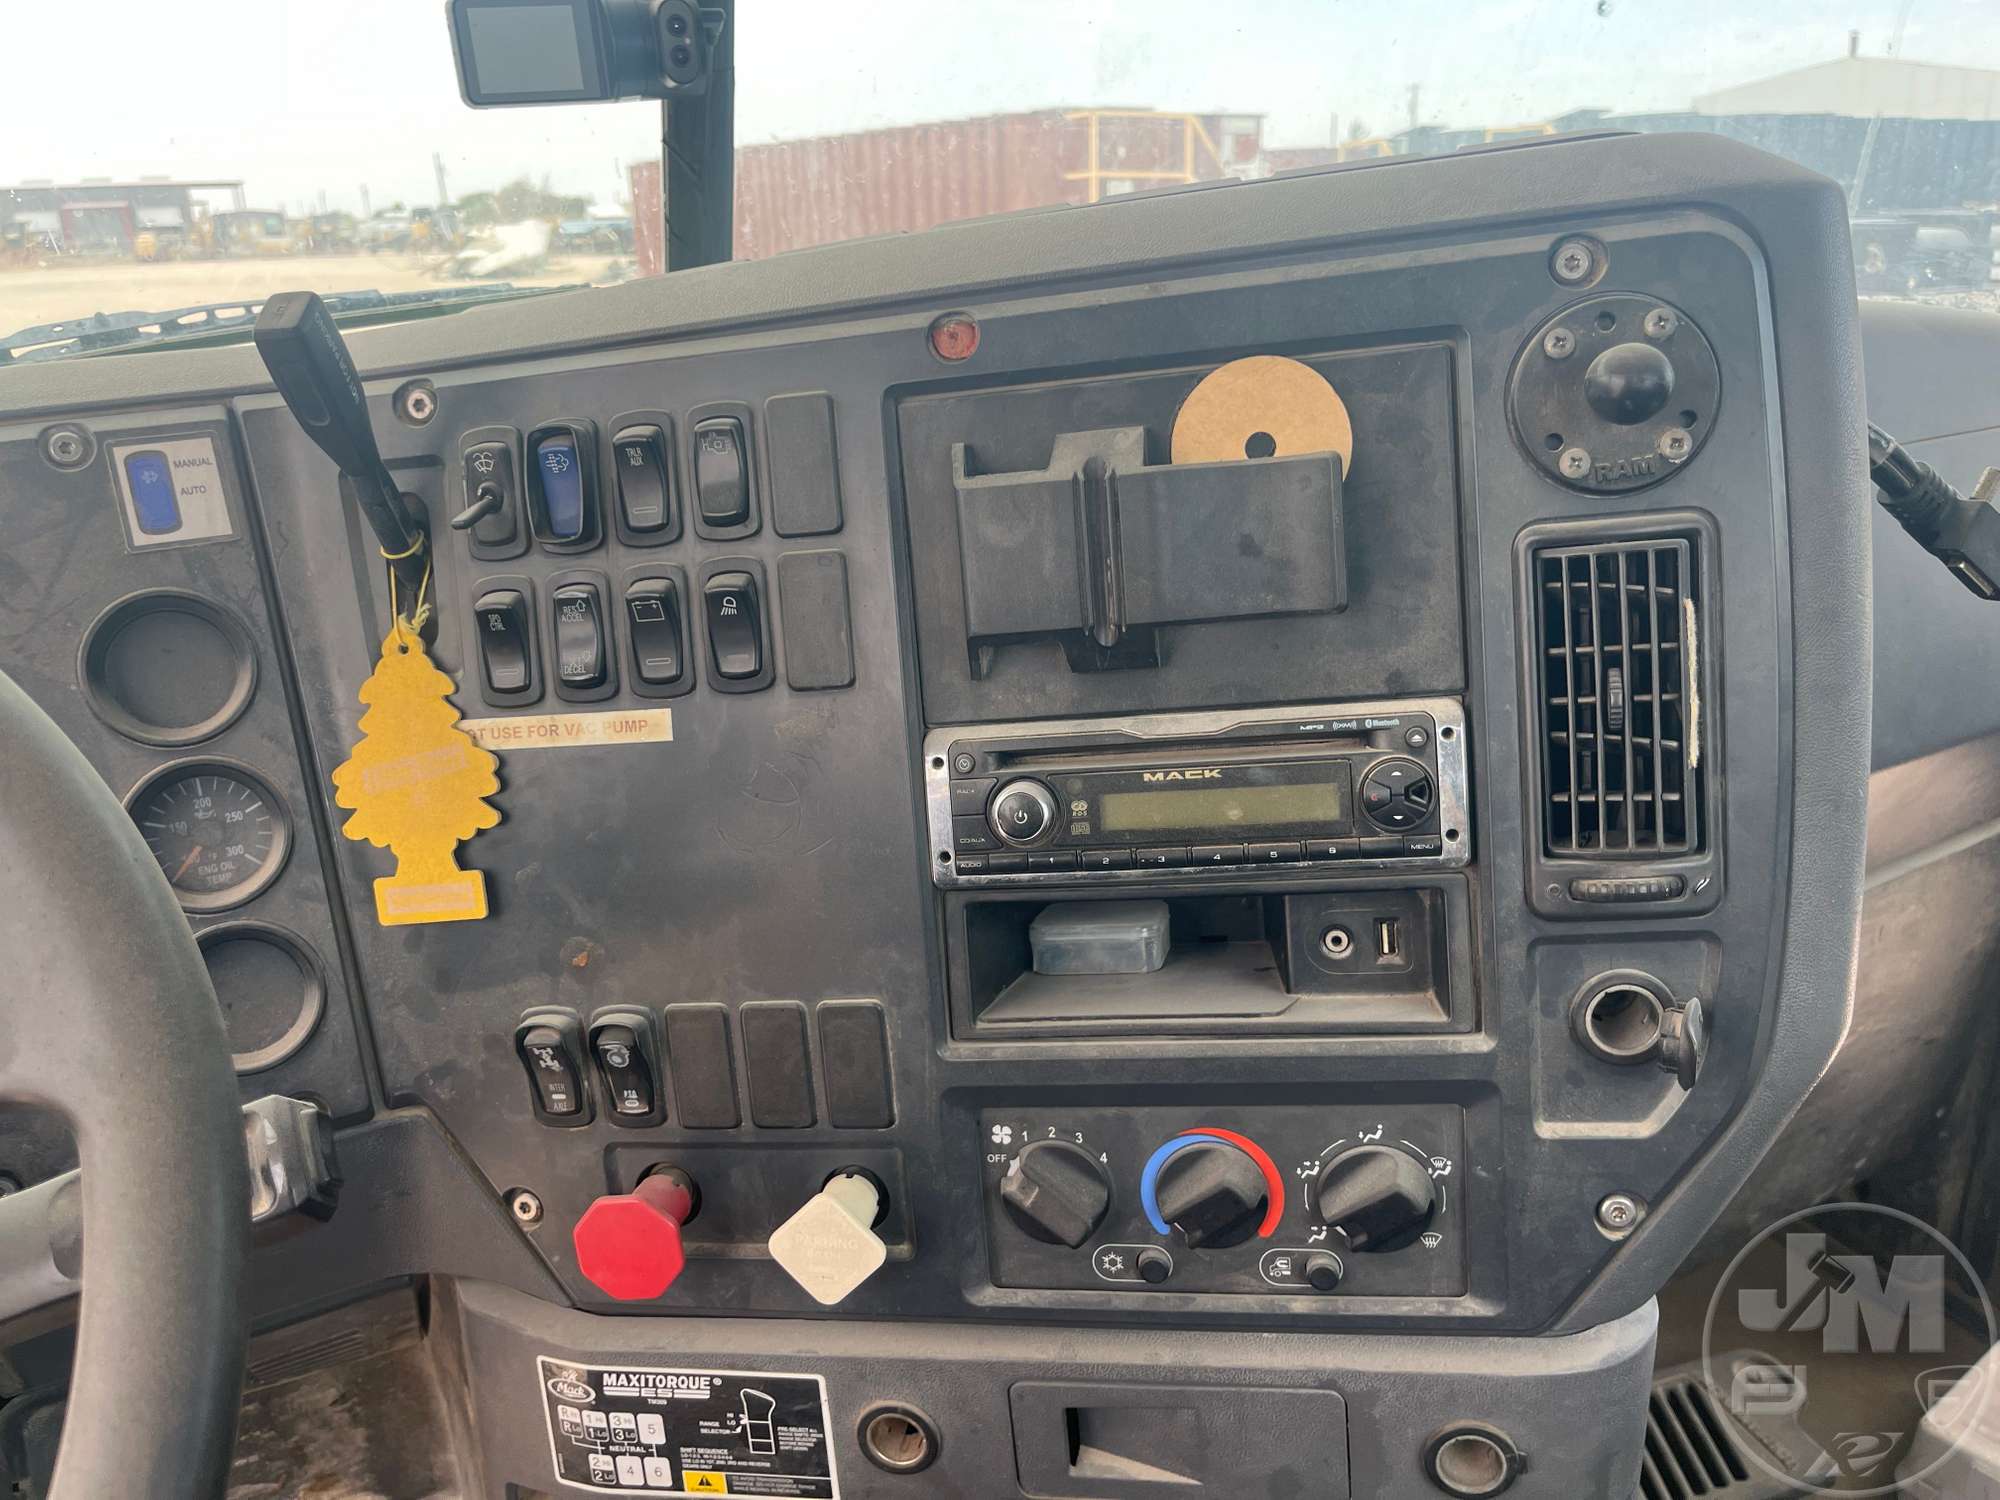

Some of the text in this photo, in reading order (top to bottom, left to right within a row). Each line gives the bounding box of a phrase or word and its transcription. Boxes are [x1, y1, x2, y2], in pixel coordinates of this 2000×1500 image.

[625, 447, 643, 457] TRLR
[173, 457, 214, 469] MANUAL
[630, 457, 644, 467] AUX
[1594, 457, 1657, 483] RAM
[180, 485, 207, 497] AUTO
[561, 613, 585, 623] ACCEL
[564, 663, 587, 675] DECEL
[490, 726, 523, 740] USE
[527, 724, 560, 738] FOR
[602, 718, 649, 734] PUMP
[1143, 769, 1223, 782] MACK
[193, 796, 212, 809] 200
[225, 810, 244, 824] 250
[168, 821, 188, 837] 150
[225, 844, 245, 858] 300
[1270, 851, 1278, 859] 5
[1328, 846, 1337, 855] 6
[1102, 857, 1110, 865] 2
[1157, 855, 1165, 863] 3
[1213, 853, 1221, 861] 4
[198, 860, 237, 876] ENG OIL
[960, 861, 982, 869] AUDIO
[206, 872, 233, 885] TEMP
[1021, 1130, 1029, 1142] 1
[1047, 1126, 1057, 1138] 2
[1074, 1131, 1084, 1144] 3
[986, 1153, 1007, 1163] OFF
[1099, 1151, 1109, 1164] 4
[602, 1372, 711, 1390] MAXITORQUE
[556, 1381, 587, 1396] Mack
[561, 1407, 569, 1417] R
[613, 1415, 622, 1426] 3
[563, 1422, 572, 1433] R
[588, 1427, 595, 1439] 1
[647, 1424, 657, 1435] 5
[615, 1429, 624, 1440] 3
[608, 1445, 646, 1453] NEUTRAL
[592, 1456, 601, 1467] 2
[594, 1470, 604, 1481] 2
[627, 1465, 635, 1476] 4
[653, 1466, 663, 1478] 6
